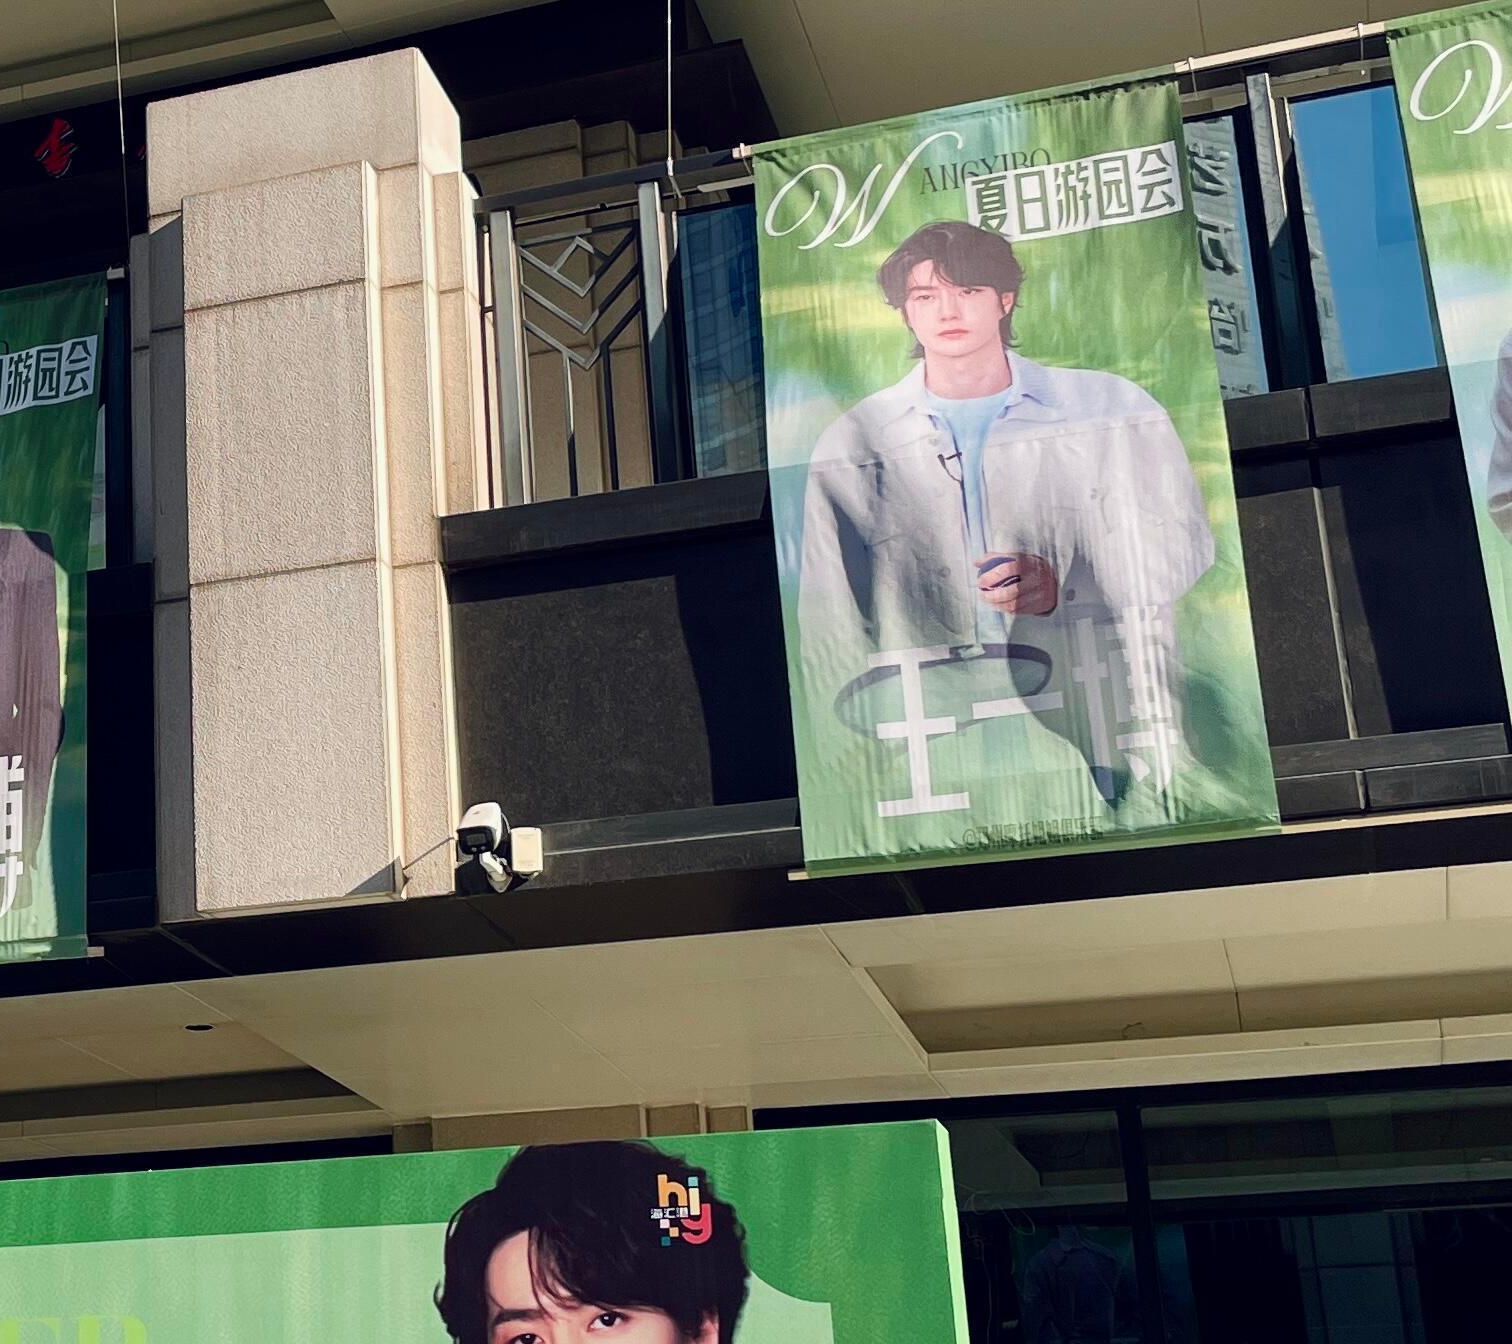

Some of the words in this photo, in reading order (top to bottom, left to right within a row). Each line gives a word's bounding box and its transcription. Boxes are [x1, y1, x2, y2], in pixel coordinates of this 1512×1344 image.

[972, 148, 1176, 234] 夏日游园会
[868, 605, 1178, 818] 王一博
